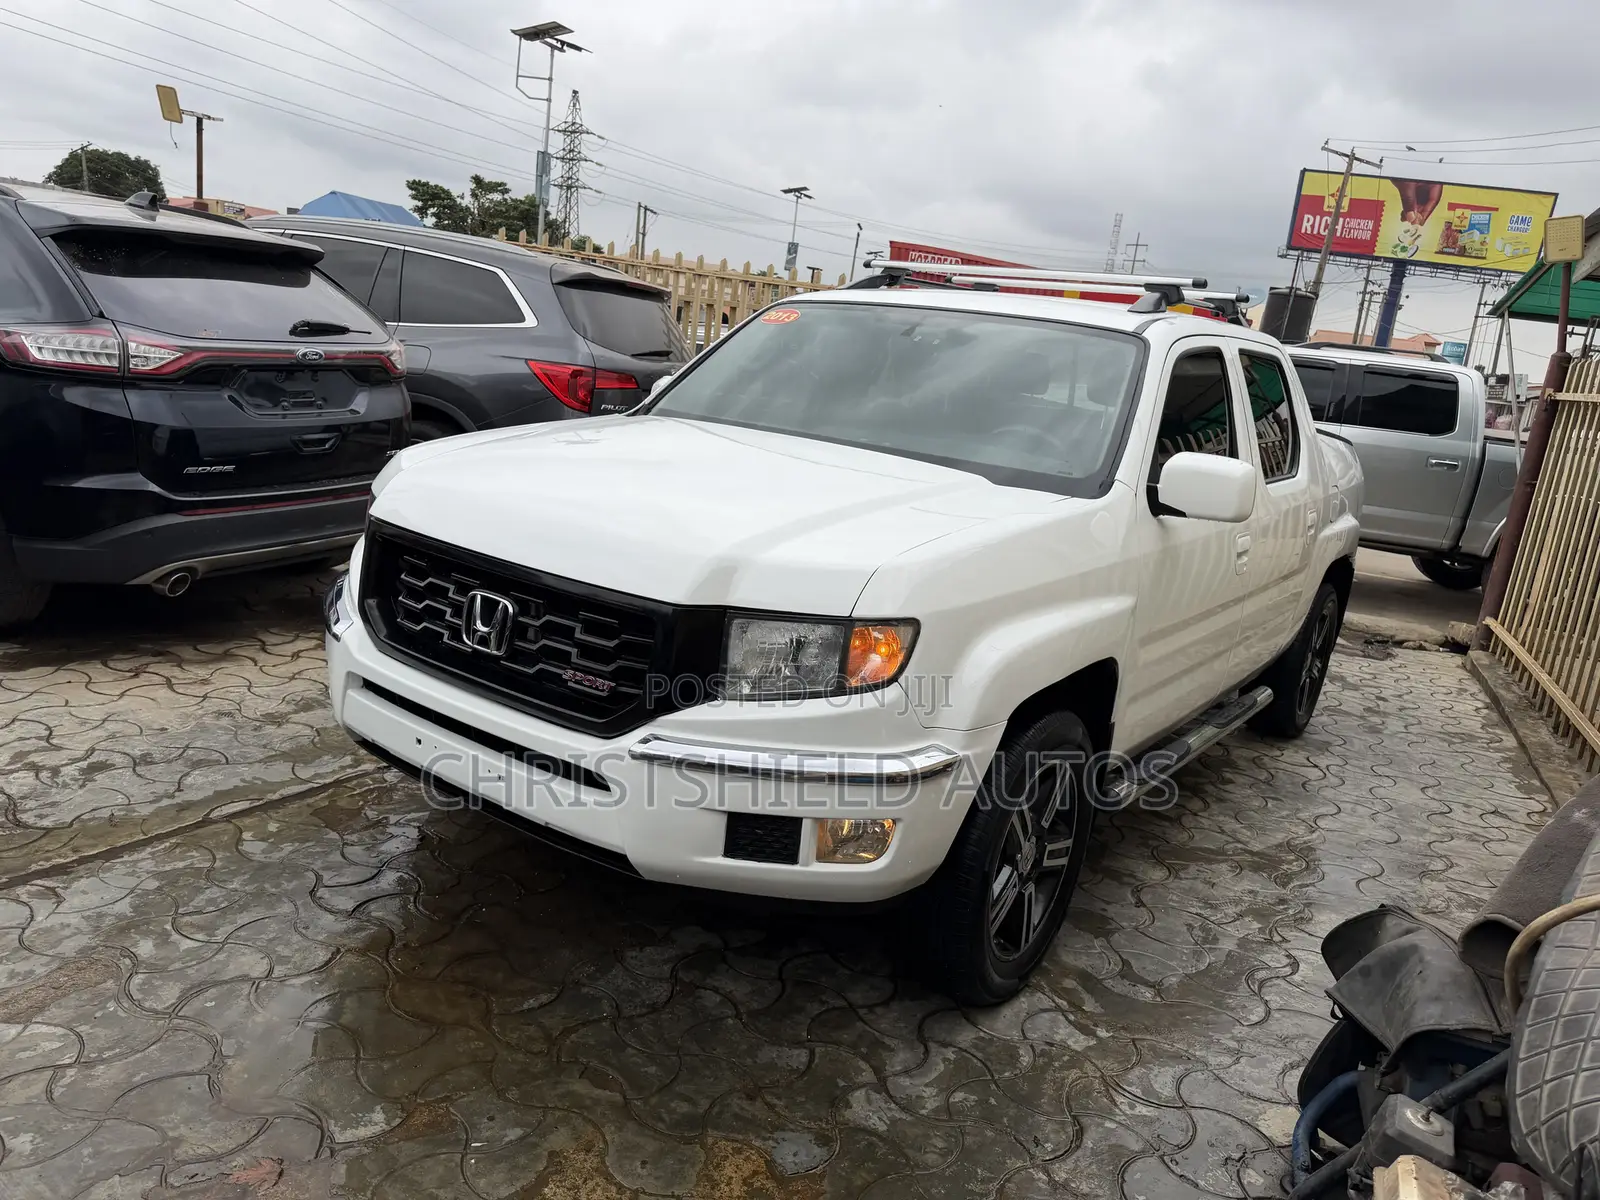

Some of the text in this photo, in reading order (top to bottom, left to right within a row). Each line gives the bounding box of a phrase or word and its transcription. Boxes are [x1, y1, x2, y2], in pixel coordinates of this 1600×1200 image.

[1301, 214, 1344, 237] RICH
[1344, 217, 1374, 231] CHICKEN
[1342, 228, 1372, 240] FLAVOUR
[762, 311, 799, 322] 2013
[305, 351, 320, 360] Ford
[183, 465, 236, 474] EDGE
[562, 669, 617, 692] SPORT
